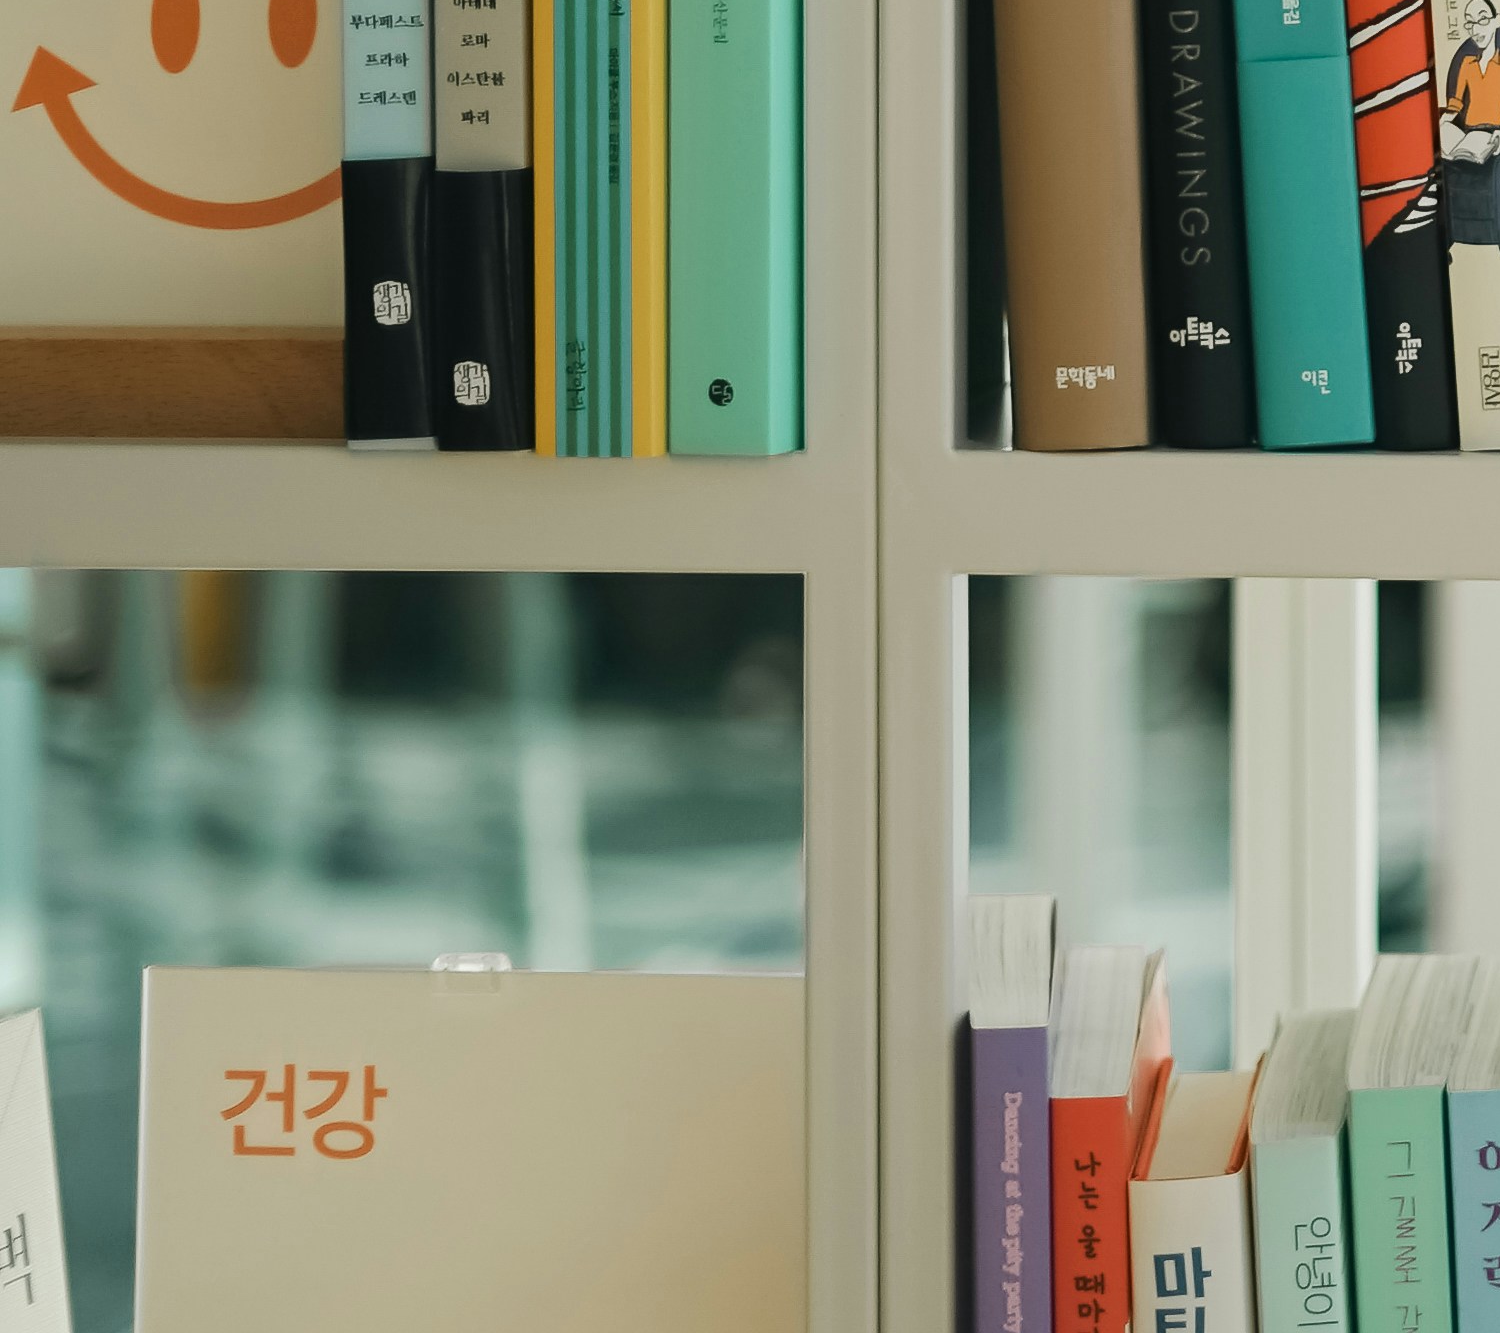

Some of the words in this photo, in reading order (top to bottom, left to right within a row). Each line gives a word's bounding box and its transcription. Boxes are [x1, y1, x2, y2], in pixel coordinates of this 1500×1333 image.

[460, 33, 490, 48] 로마
[365, 53, 410, 67] 프라하
[460, 109, 490, 124] 파리
[1168, 10, 1213, 268] DRAWINGS
[220, 1063, 388, 1160] 건강
[999, 1090, 1024, 1174] Dancing
[1004, 1180, 1022, 1198] at
[1074, 1151, 1101, 1211] 나는
[1003, 1204, 1023, 1235] the
[1001, 1237, 1023, 1277] pity
[1078, 1224, 1101, 1259] 울
